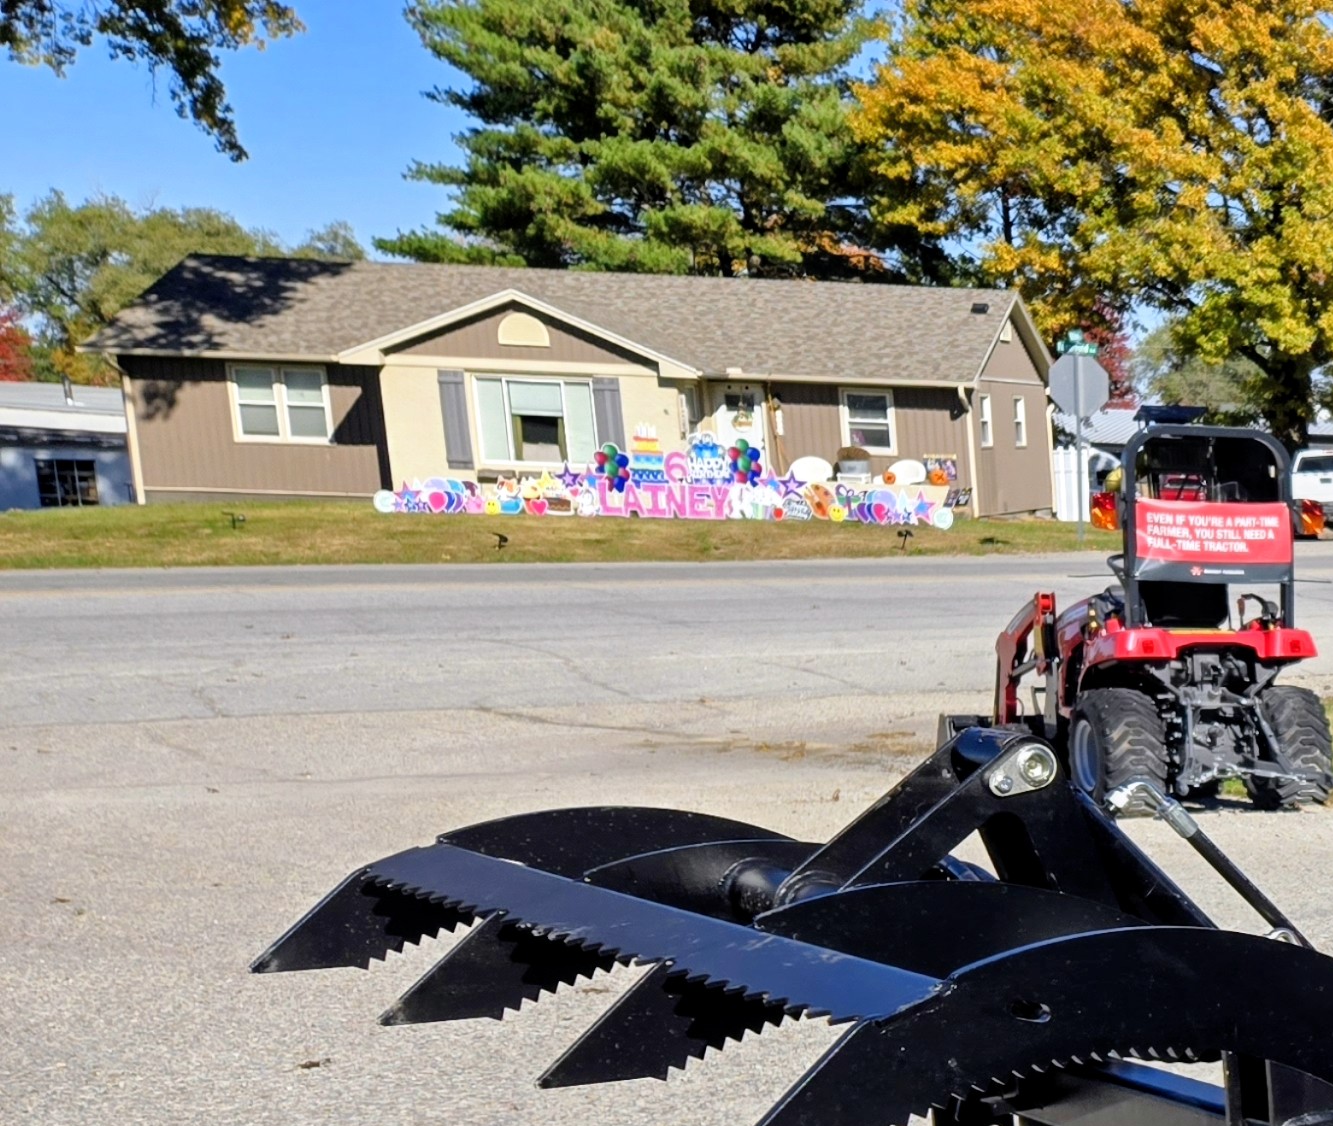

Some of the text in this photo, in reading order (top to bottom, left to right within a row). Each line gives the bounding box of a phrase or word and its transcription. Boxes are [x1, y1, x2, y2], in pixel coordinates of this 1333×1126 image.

[664, 451, 688, 484] 6
[598, 481, 731, 519] LAINEY
[1146, 512, 1280, 528] EVEN IF YOU'RE A PART-TIME
[1147, 525, 1276, 540] FARMER, YOU STILL NEED A
[1147, 537, 1250, 553] FULL-TIME TRACTOR.
